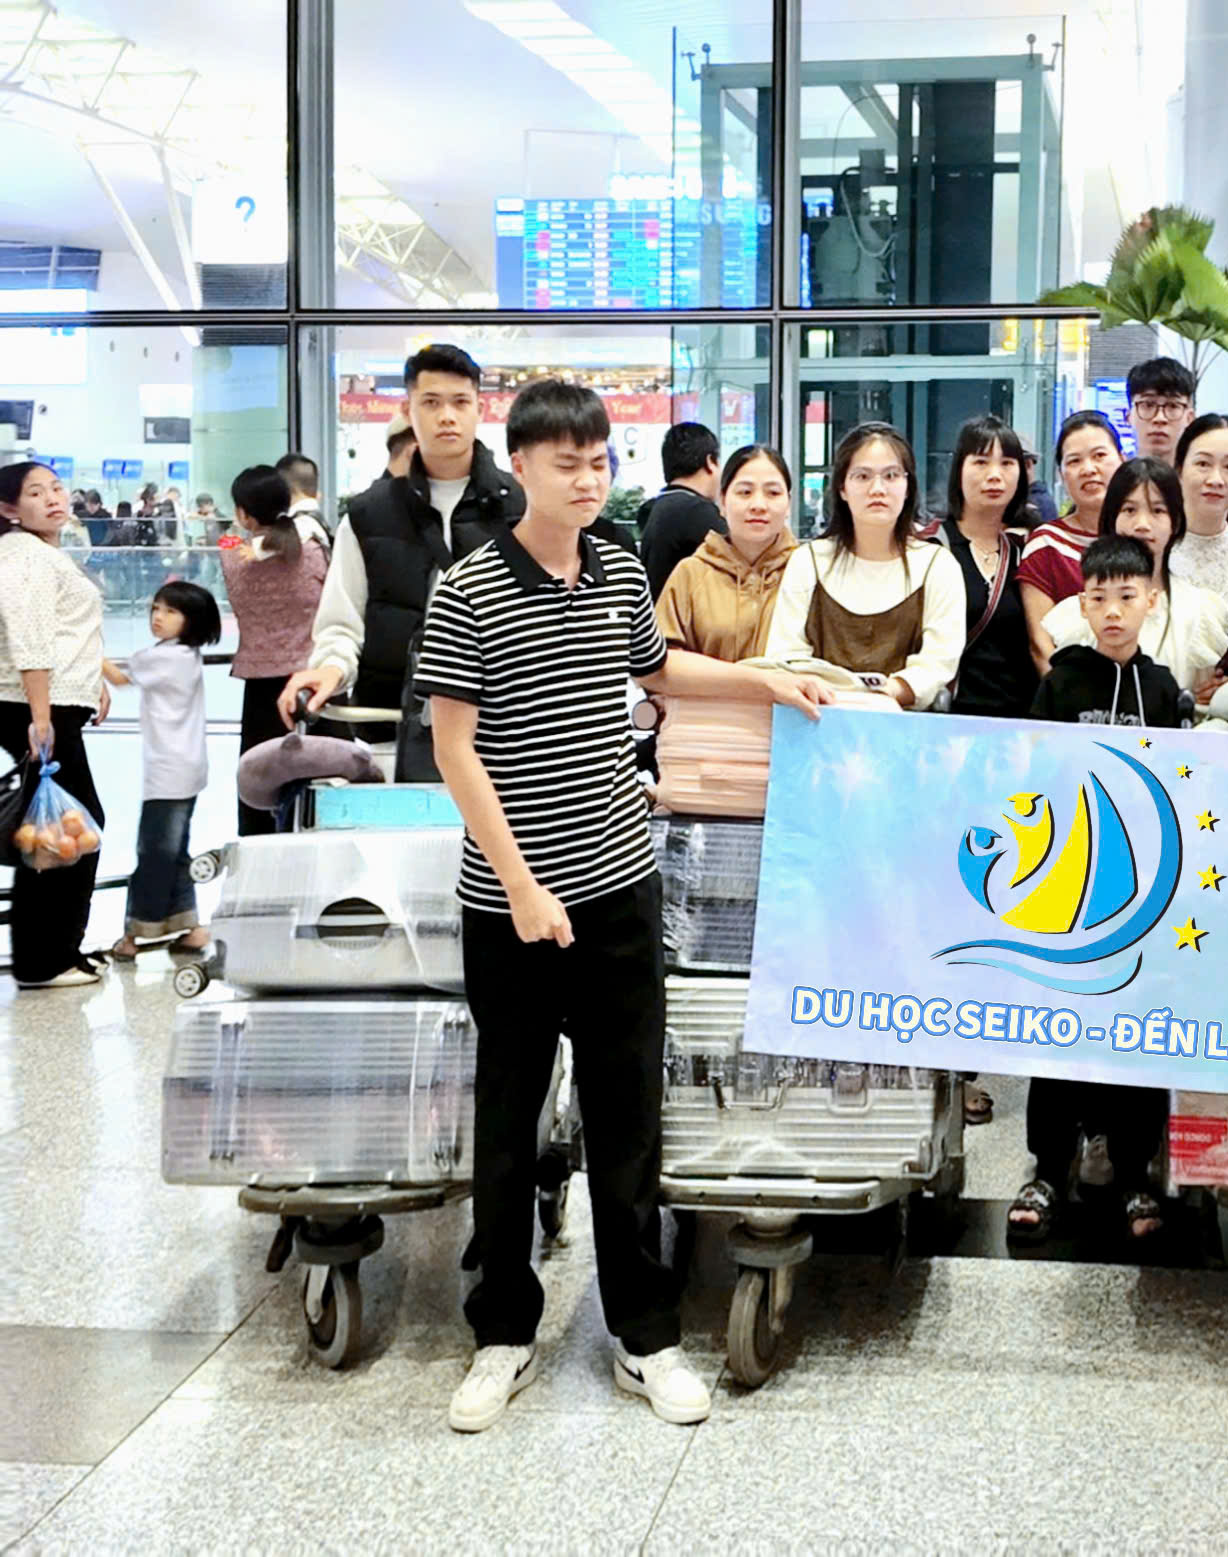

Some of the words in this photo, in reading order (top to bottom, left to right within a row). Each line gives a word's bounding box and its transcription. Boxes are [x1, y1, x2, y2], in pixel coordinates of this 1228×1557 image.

[791, 985, 854, 1028] DU
[859, 991, 952, 1043] HỌC
[954, 1000, 1081, 1047] SEIKO
[1086, 1026, 1105, 1041] -
[1110, 1007, 1199, 1057] ĐẾN
